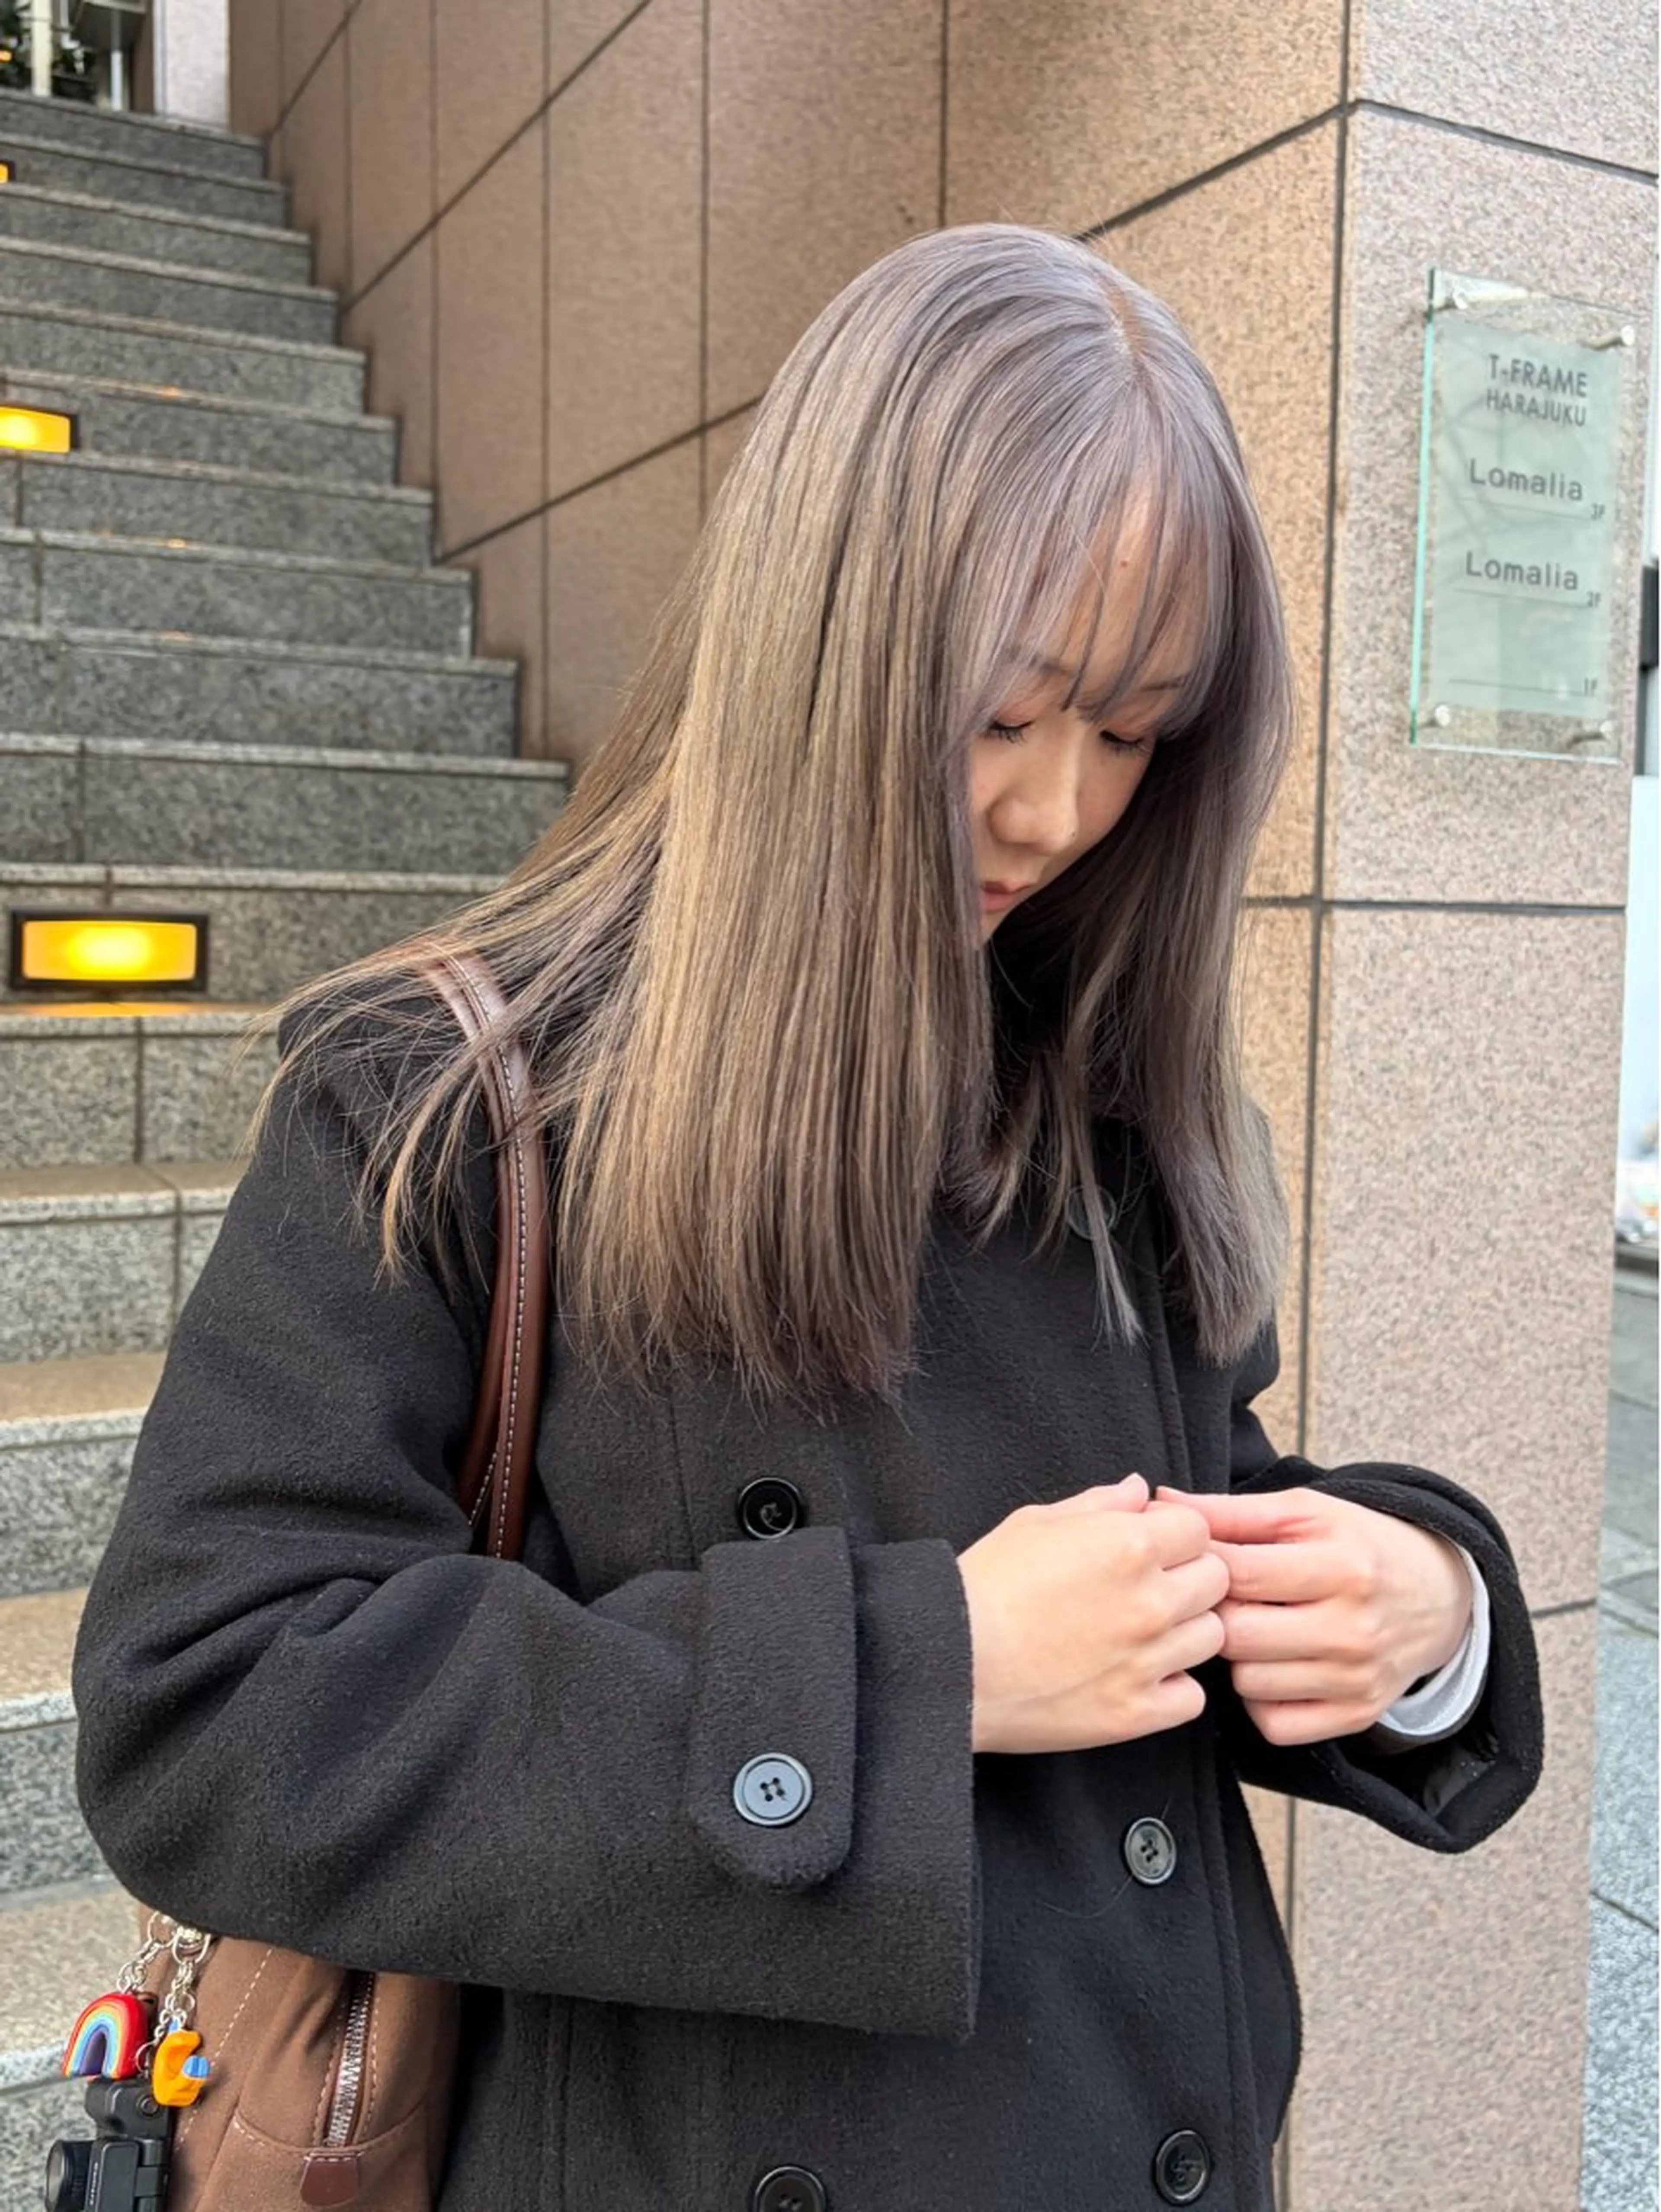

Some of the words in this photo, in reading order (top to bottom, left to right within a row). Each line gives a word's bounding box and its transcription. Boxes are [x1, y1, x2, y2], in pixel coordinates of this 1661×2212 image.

[1489, 354, 1588, 398] T-FRAME
[1486, 389, 1586, 426] HARAJUKU
[1470, 458, 1583, 501] Lomalia
[1465, 550, 1579, 590] Lomalia
